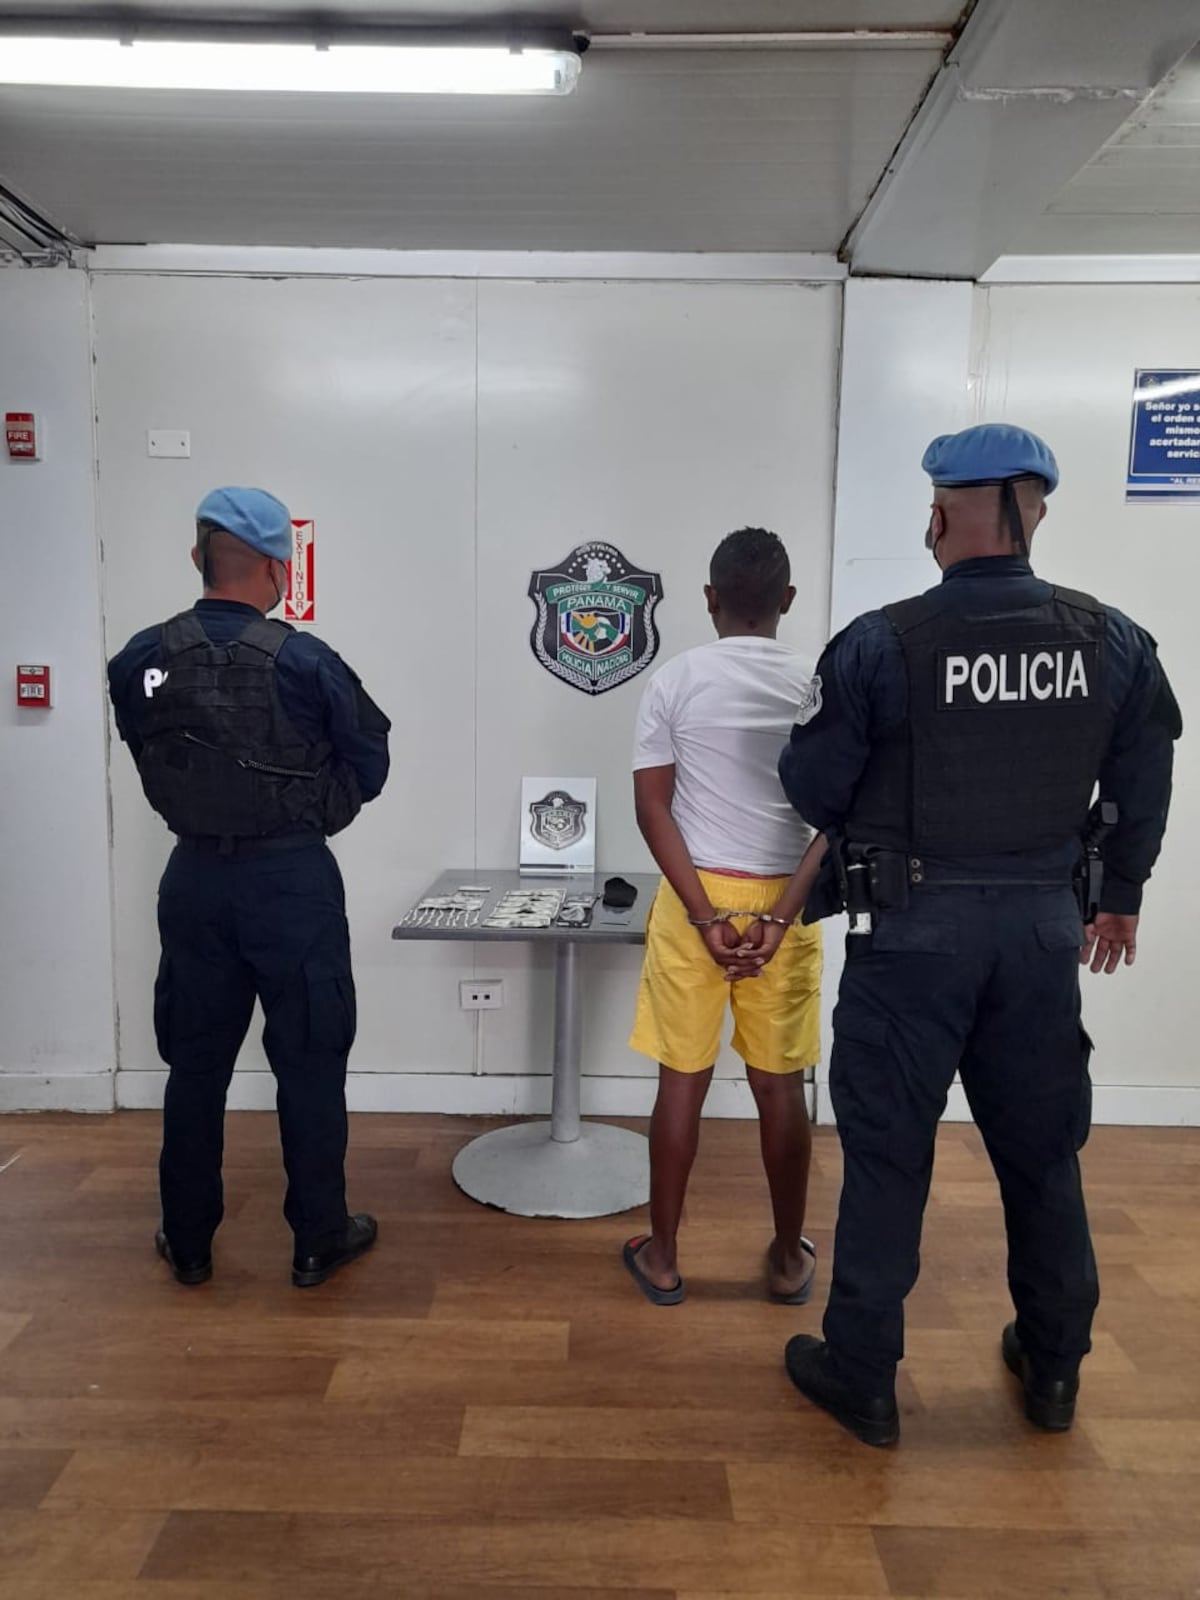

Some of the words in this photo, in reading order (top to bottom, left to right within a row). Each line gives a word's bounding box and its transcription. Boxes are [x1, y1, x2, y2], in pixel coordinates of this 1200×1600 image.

[1145, 402, 1175, 411] Señor
[1178, 404, 1191, 412] yo
[1151, 414, 1162, 423] el
[1163, 414, 1195, 423] orden
[8, 431, 29, 440] FIRE
[295, 531, 304, 610] EXTINTOR
[613, 585, 639, 599] SERVIR
[567, 595, 626, 611] PANAMA
[562, 653, 592, 676] POLICIA
[945, 650, 1089, 704] POLICIA
[21, 686, 43, 696] FIRE
